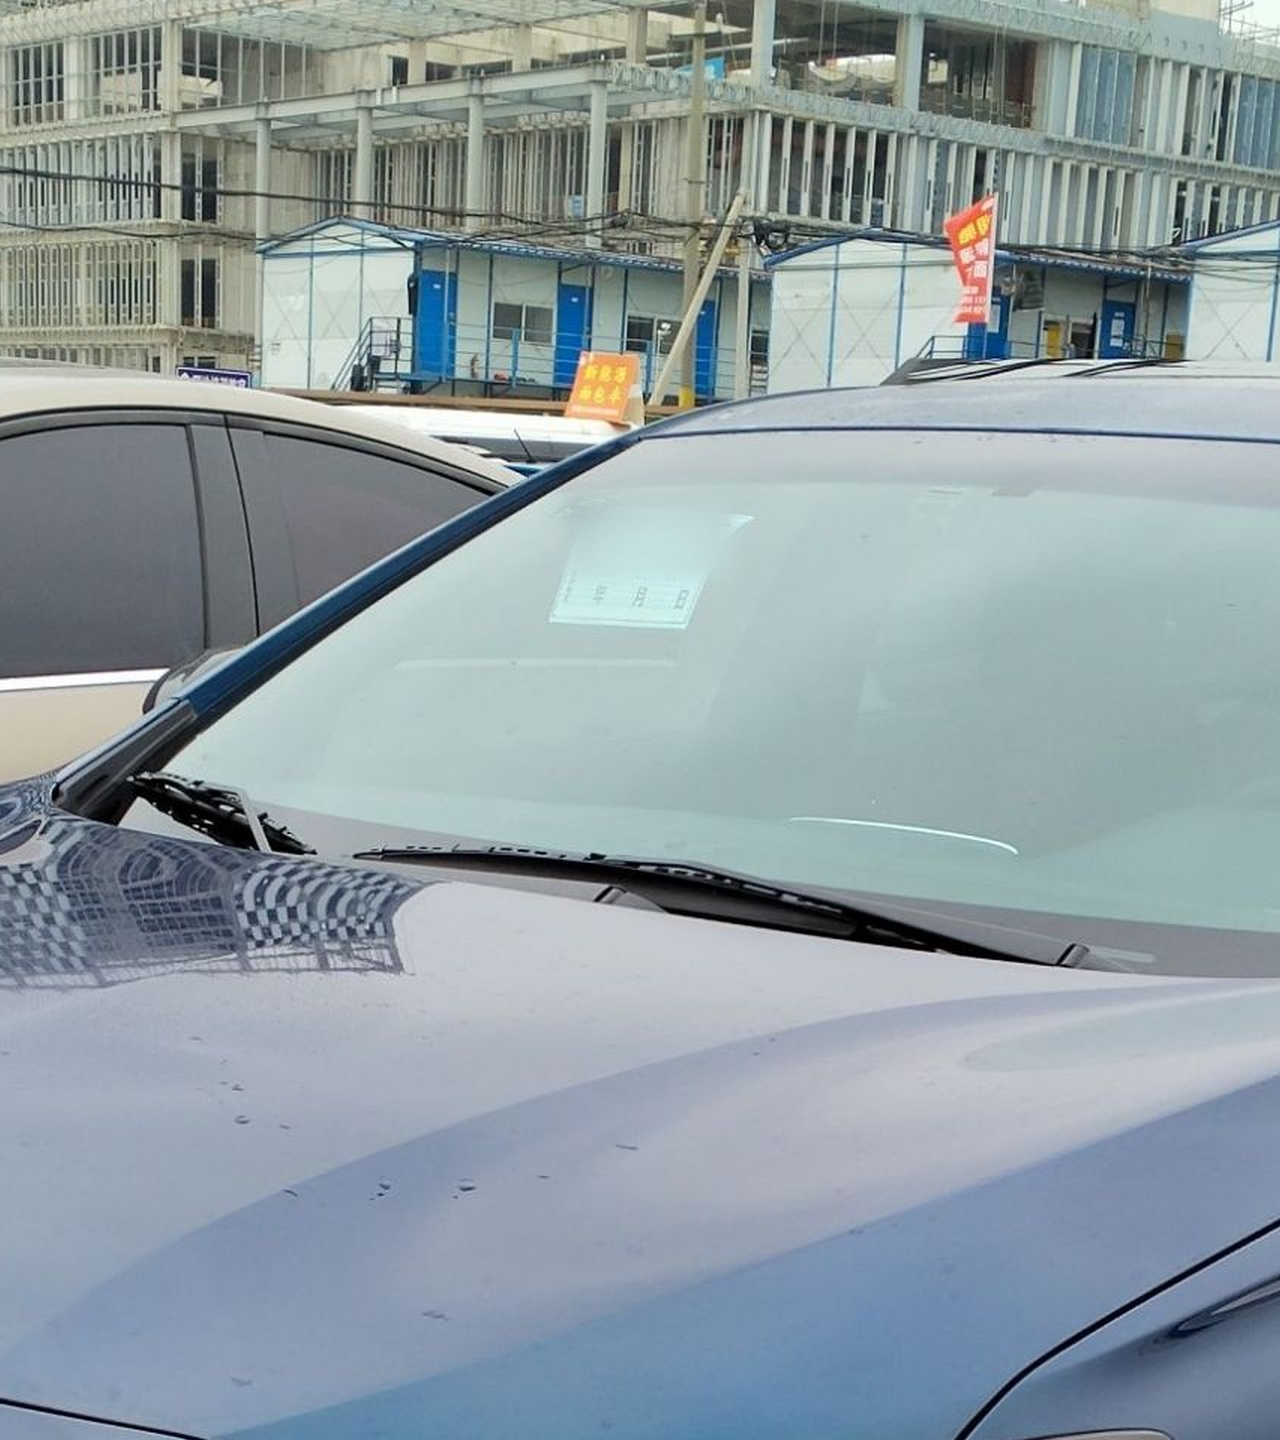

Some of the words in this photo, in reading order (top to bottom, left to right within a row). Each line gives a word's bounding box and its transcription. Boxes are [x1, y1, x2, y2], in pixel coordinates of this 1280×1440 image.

[583, 364, 628, 384] 新能源
[578, 385, 621, 405] 面包车
